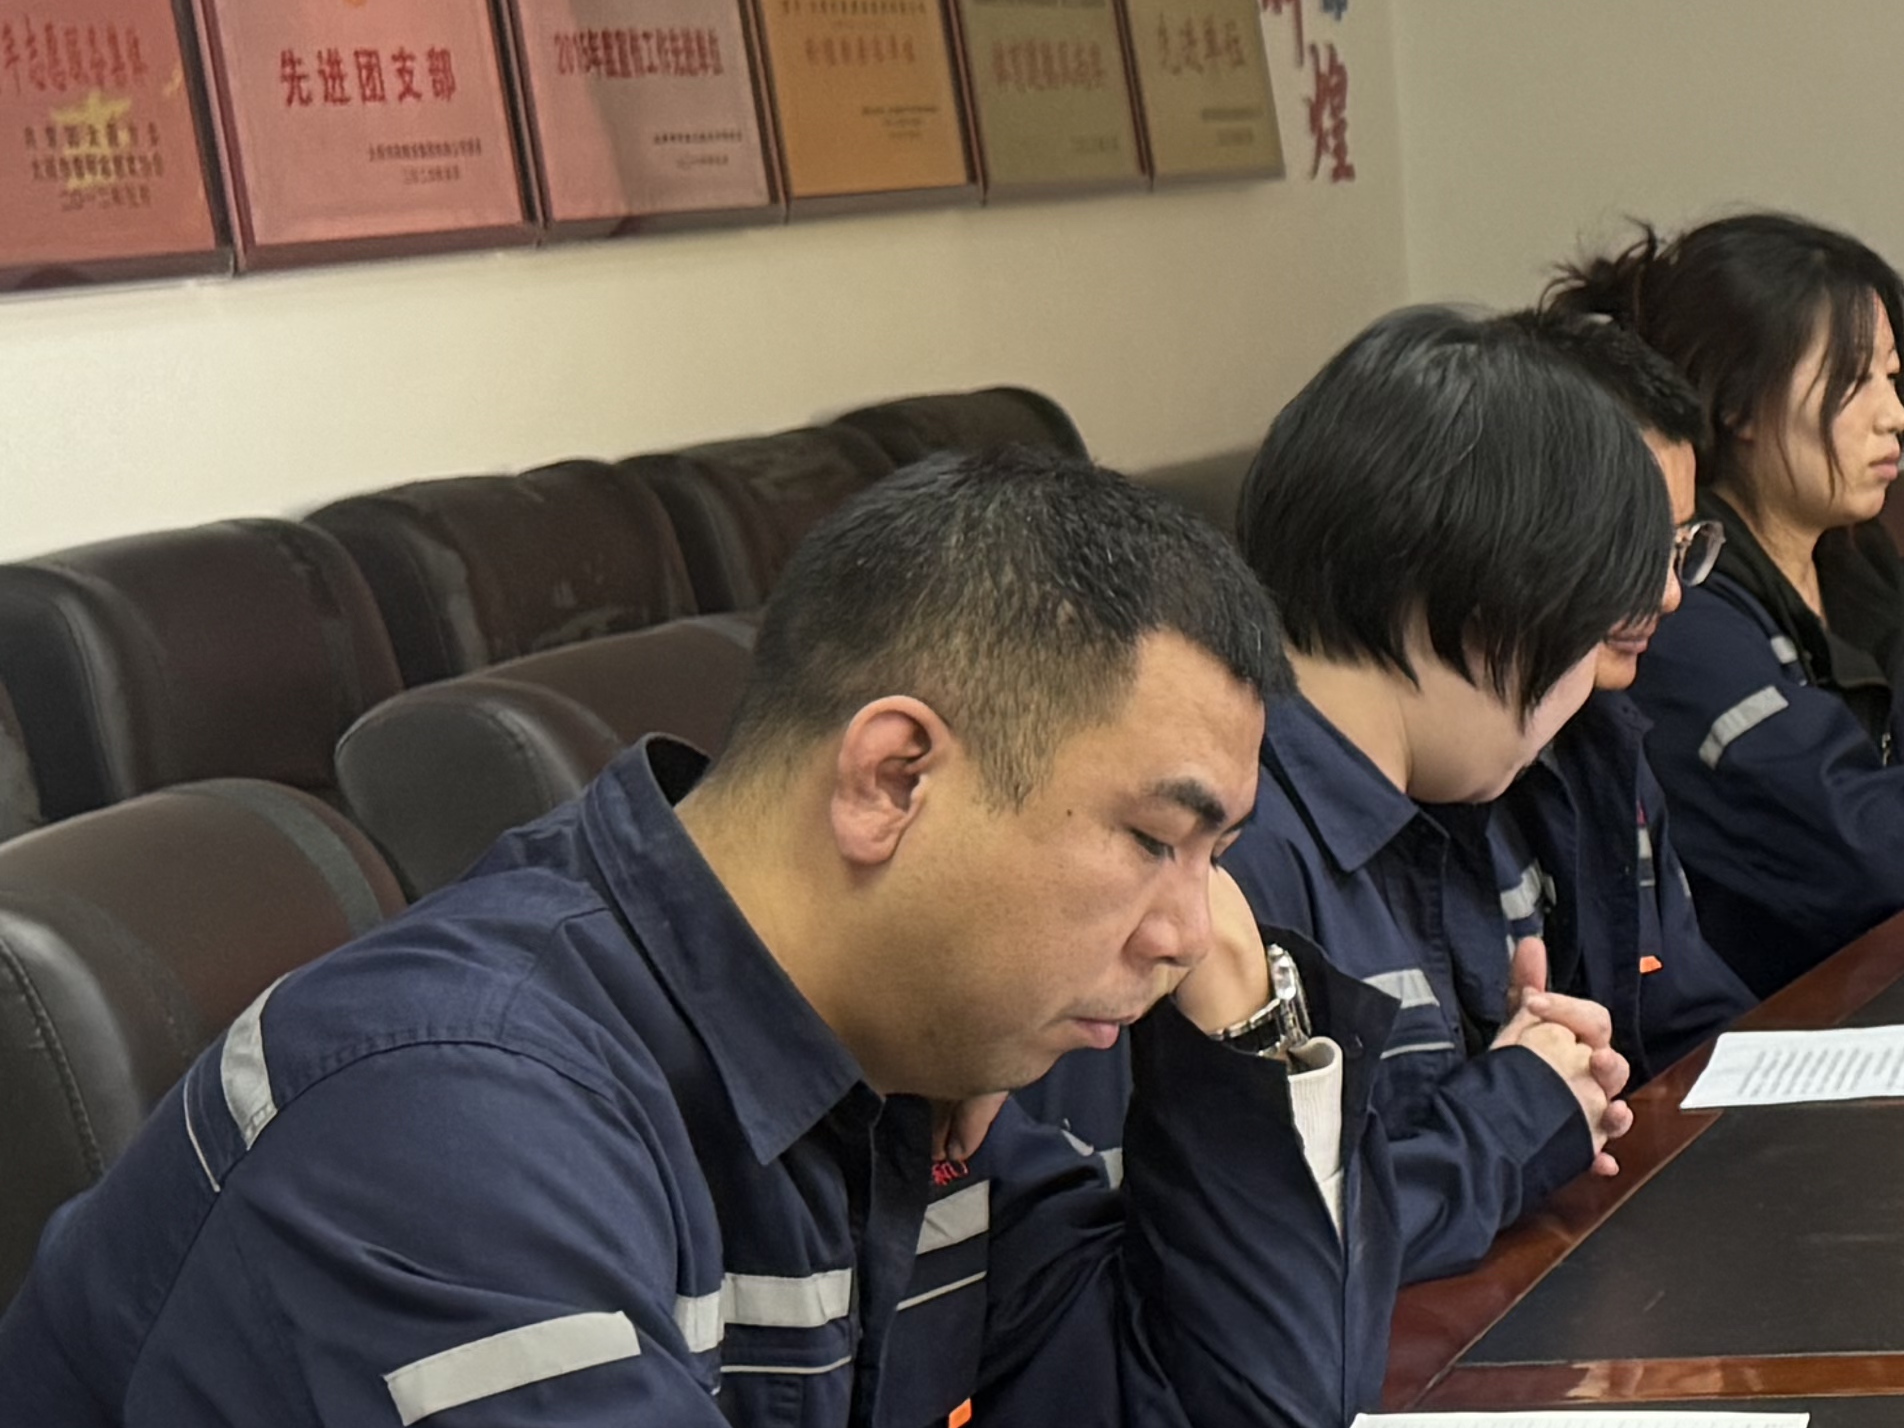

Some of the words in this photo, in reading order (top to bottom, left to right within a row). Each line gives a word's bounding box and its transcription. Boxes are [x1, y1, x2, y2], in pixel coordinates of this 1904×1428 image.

[279, 45, 458, 108] 先进团支部
